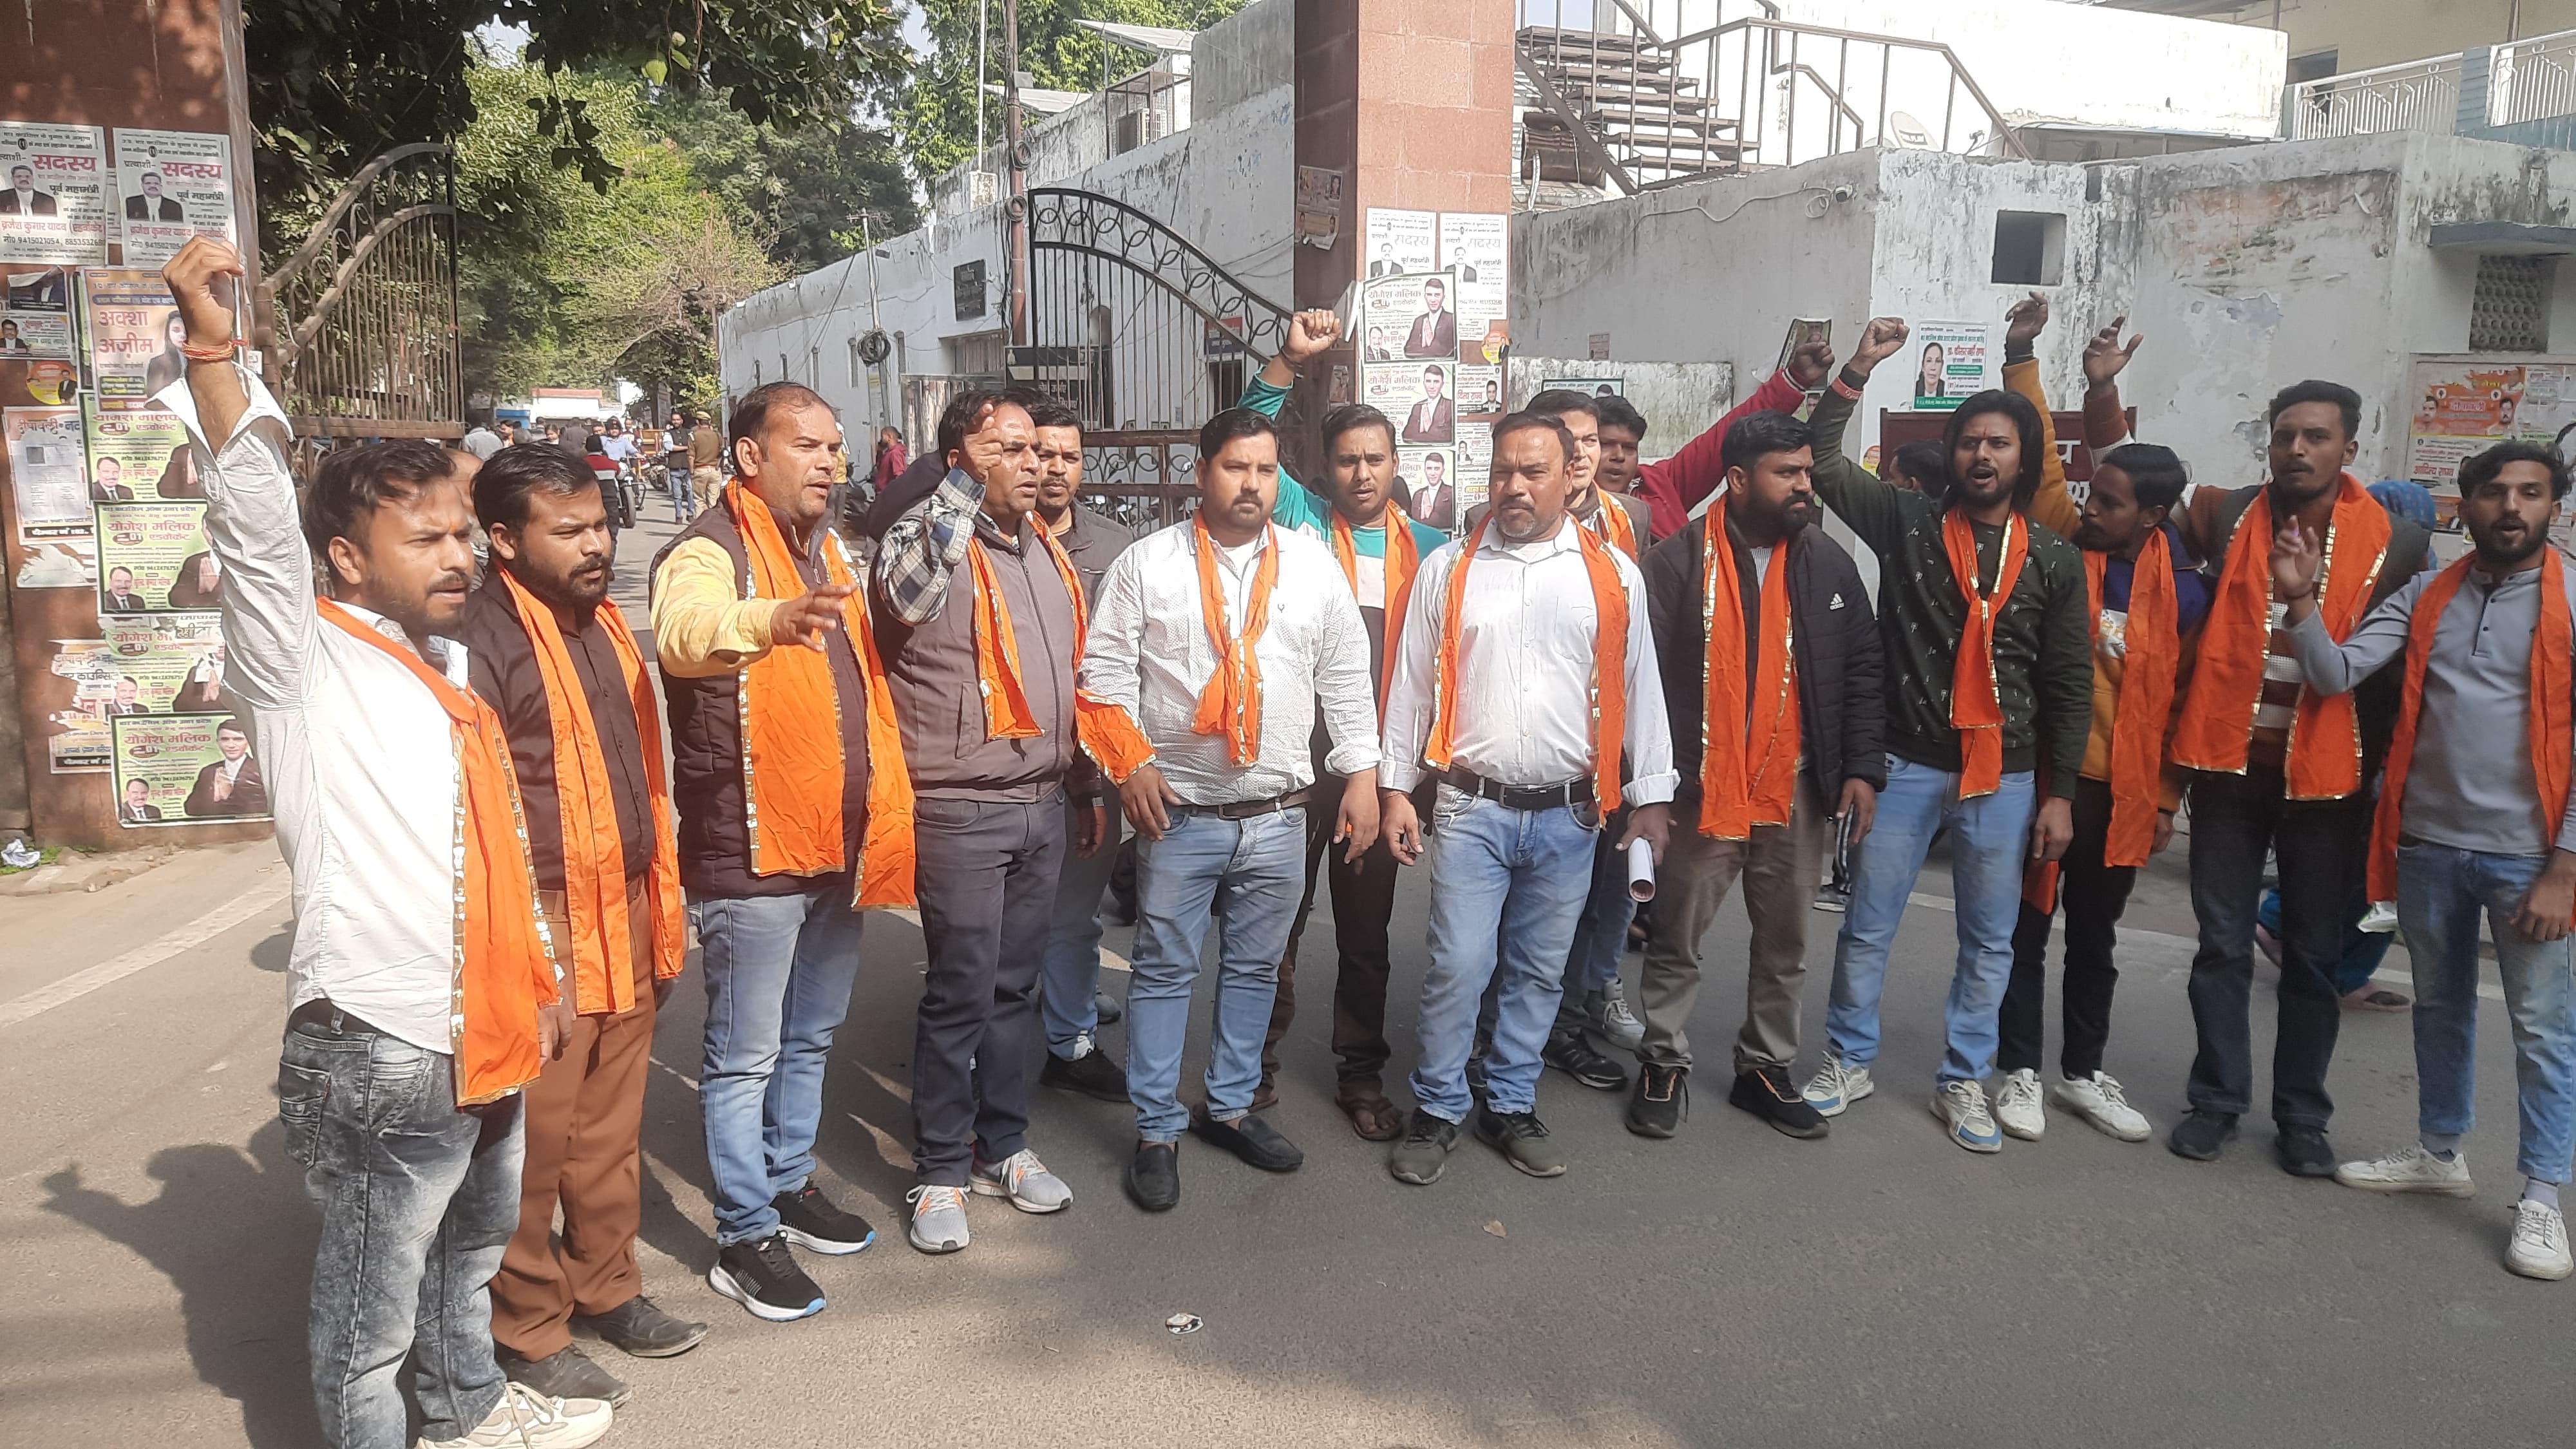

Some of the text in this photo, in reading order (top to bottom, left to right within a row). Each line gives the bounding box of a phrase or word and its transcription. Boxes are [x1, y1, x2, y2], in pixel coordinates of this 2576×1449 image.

[32, 154, 97, 172] सदस्य
[161, 162, 222, 178] सदस्य
[49, 182, 62, 195] पूर्व
[176, 190, 189, 202] पूर्व
[24, 222, 46, 234] कुमार
[47, 223, 67, 231] यादव
[99, 310, 149, 327] अक्शा
[99, 332, 154, 358] अज़ीम
[107, 520, 196, 531] योगेश मलिक
[113, 632, 152, 642] योगेश
[124, 732, 211, 744] योगेश मलिक
